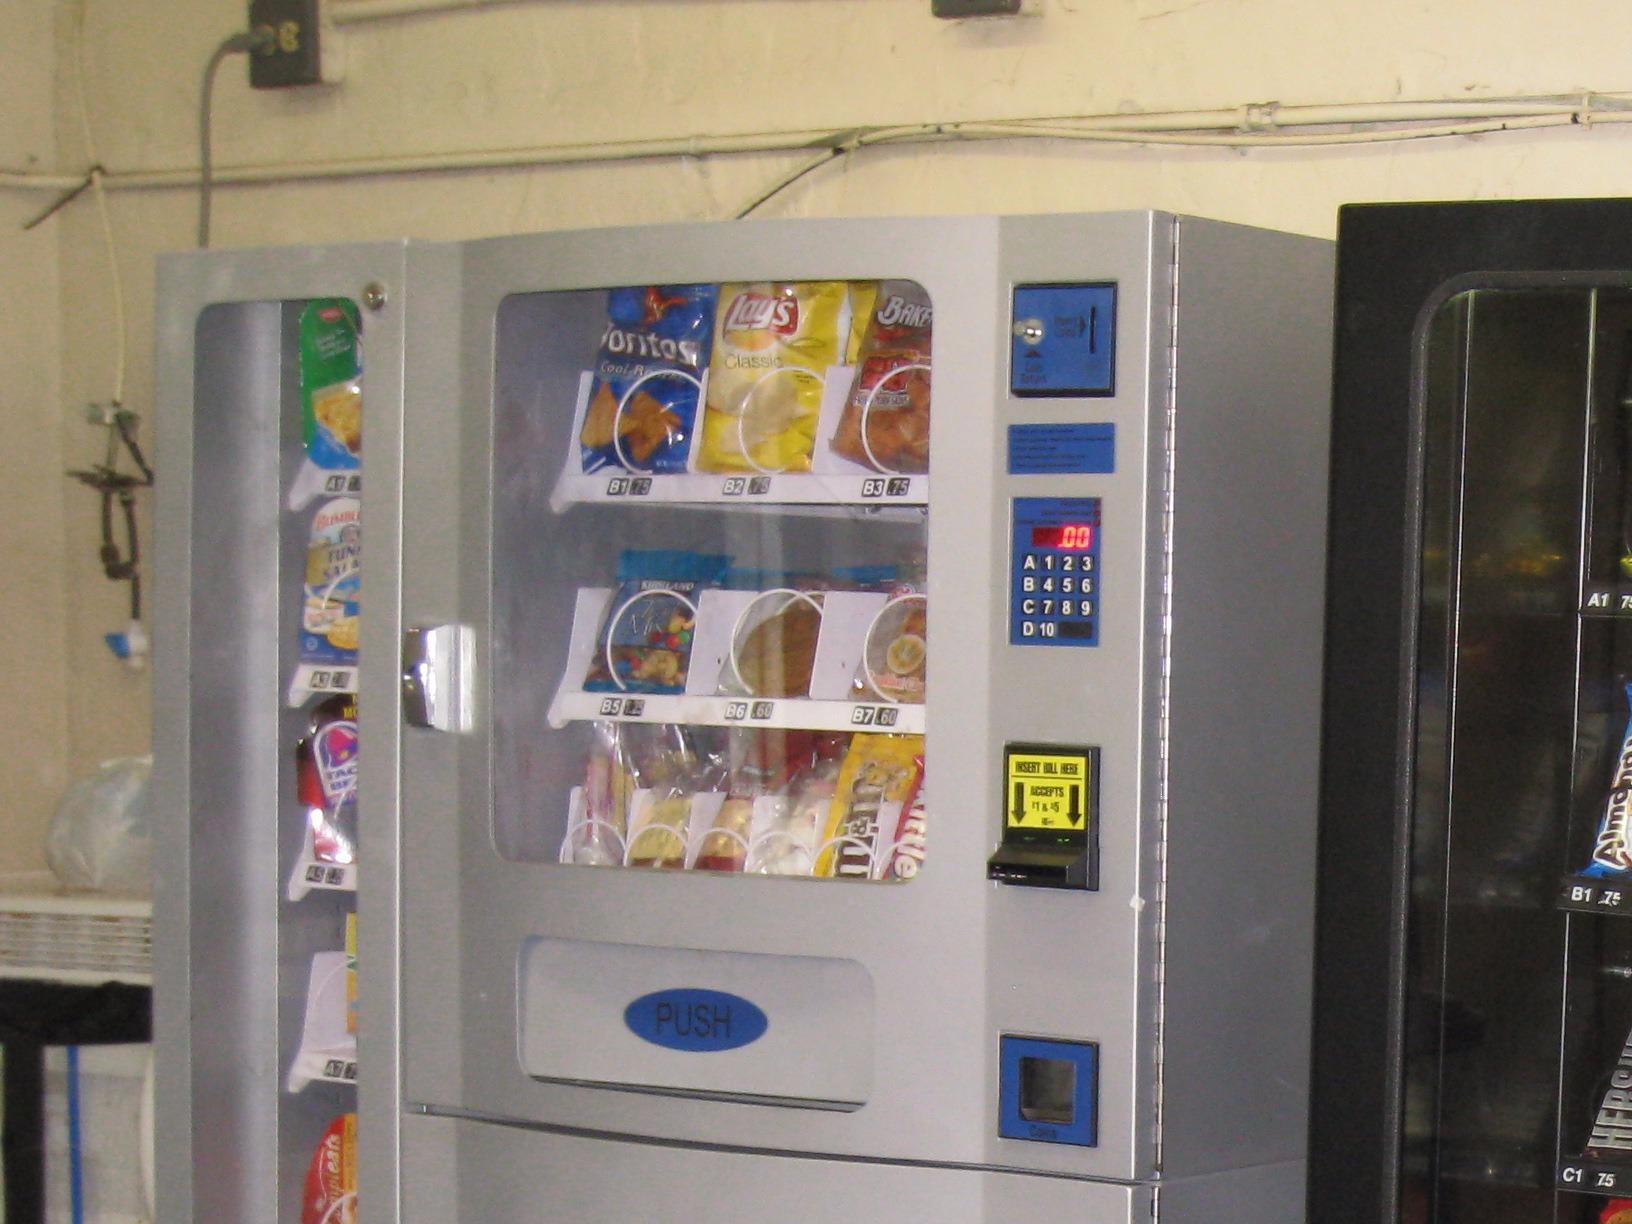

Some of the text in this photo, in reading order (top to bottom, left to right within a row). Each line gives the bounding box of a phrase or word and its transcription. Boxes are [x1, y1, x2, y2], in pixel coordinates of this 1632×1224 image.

[730, 292, 797, 335] Lay's
[724, 354, 783, 370] Classic
[862, 480, 884, 496] B3
[1023, 555, 1092, 571] A 1 2 3
[1022, 576, 1092, 593] B 4 5 6
[1022, 599, 1091, 616] C 7 8 9
[1587, 592, 1609, 607] A1
[1023, 621, 1055, 638] D 10
[725, 703, 747, 719] B6
[852, 708, 874, 724] B7
[1015, 761, 1079, 775] INSERT BILL HERE
[1030, 786, 1065, 797] ACCEPTS
[1571, 886, 1593, 903] B1
[655, 1002, 731, 1039] PUSH
[1562, 1167, 1616, 1188] C1 75
